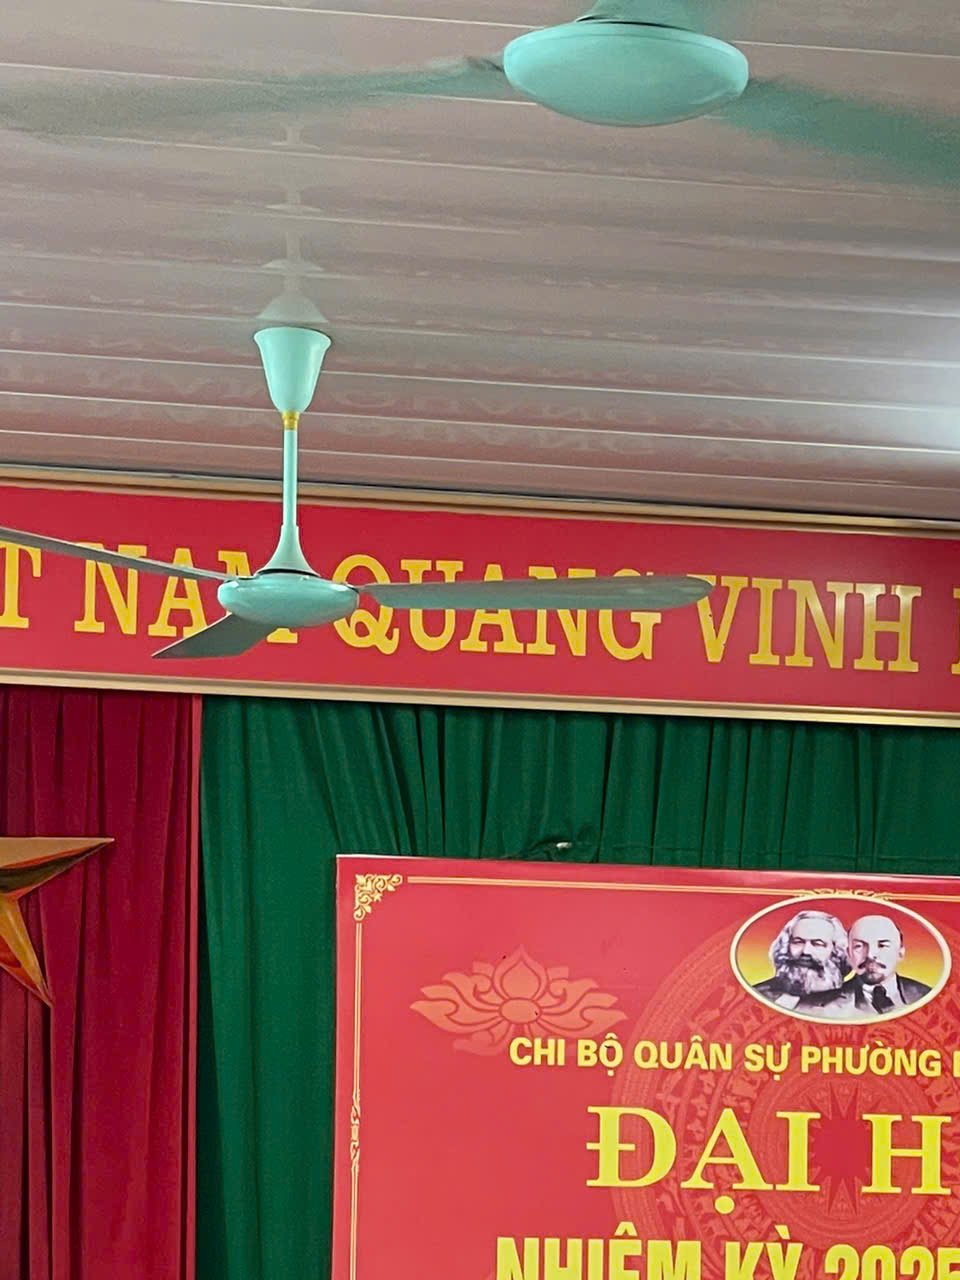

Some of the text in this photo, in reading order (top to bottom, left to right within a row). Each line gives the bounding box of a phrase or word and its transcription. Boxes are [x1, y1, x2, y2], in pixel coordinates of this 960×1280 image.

[74, 541, 298, 644] NA
[332, 555, 661, 660] QUANG
[687, 574, 921, 672] VINH
[510, 1037, 565, 1065] CHI
[578, 1033, 623, 1076] BỘ
[634, 1035, 732, 1070] QUÂN
[744, 1042, 791, 1080] SỰ
[802, 1041, 941, 1077] PHƯỜNG
[586, 1106, 820, 1214] ĐẠI
